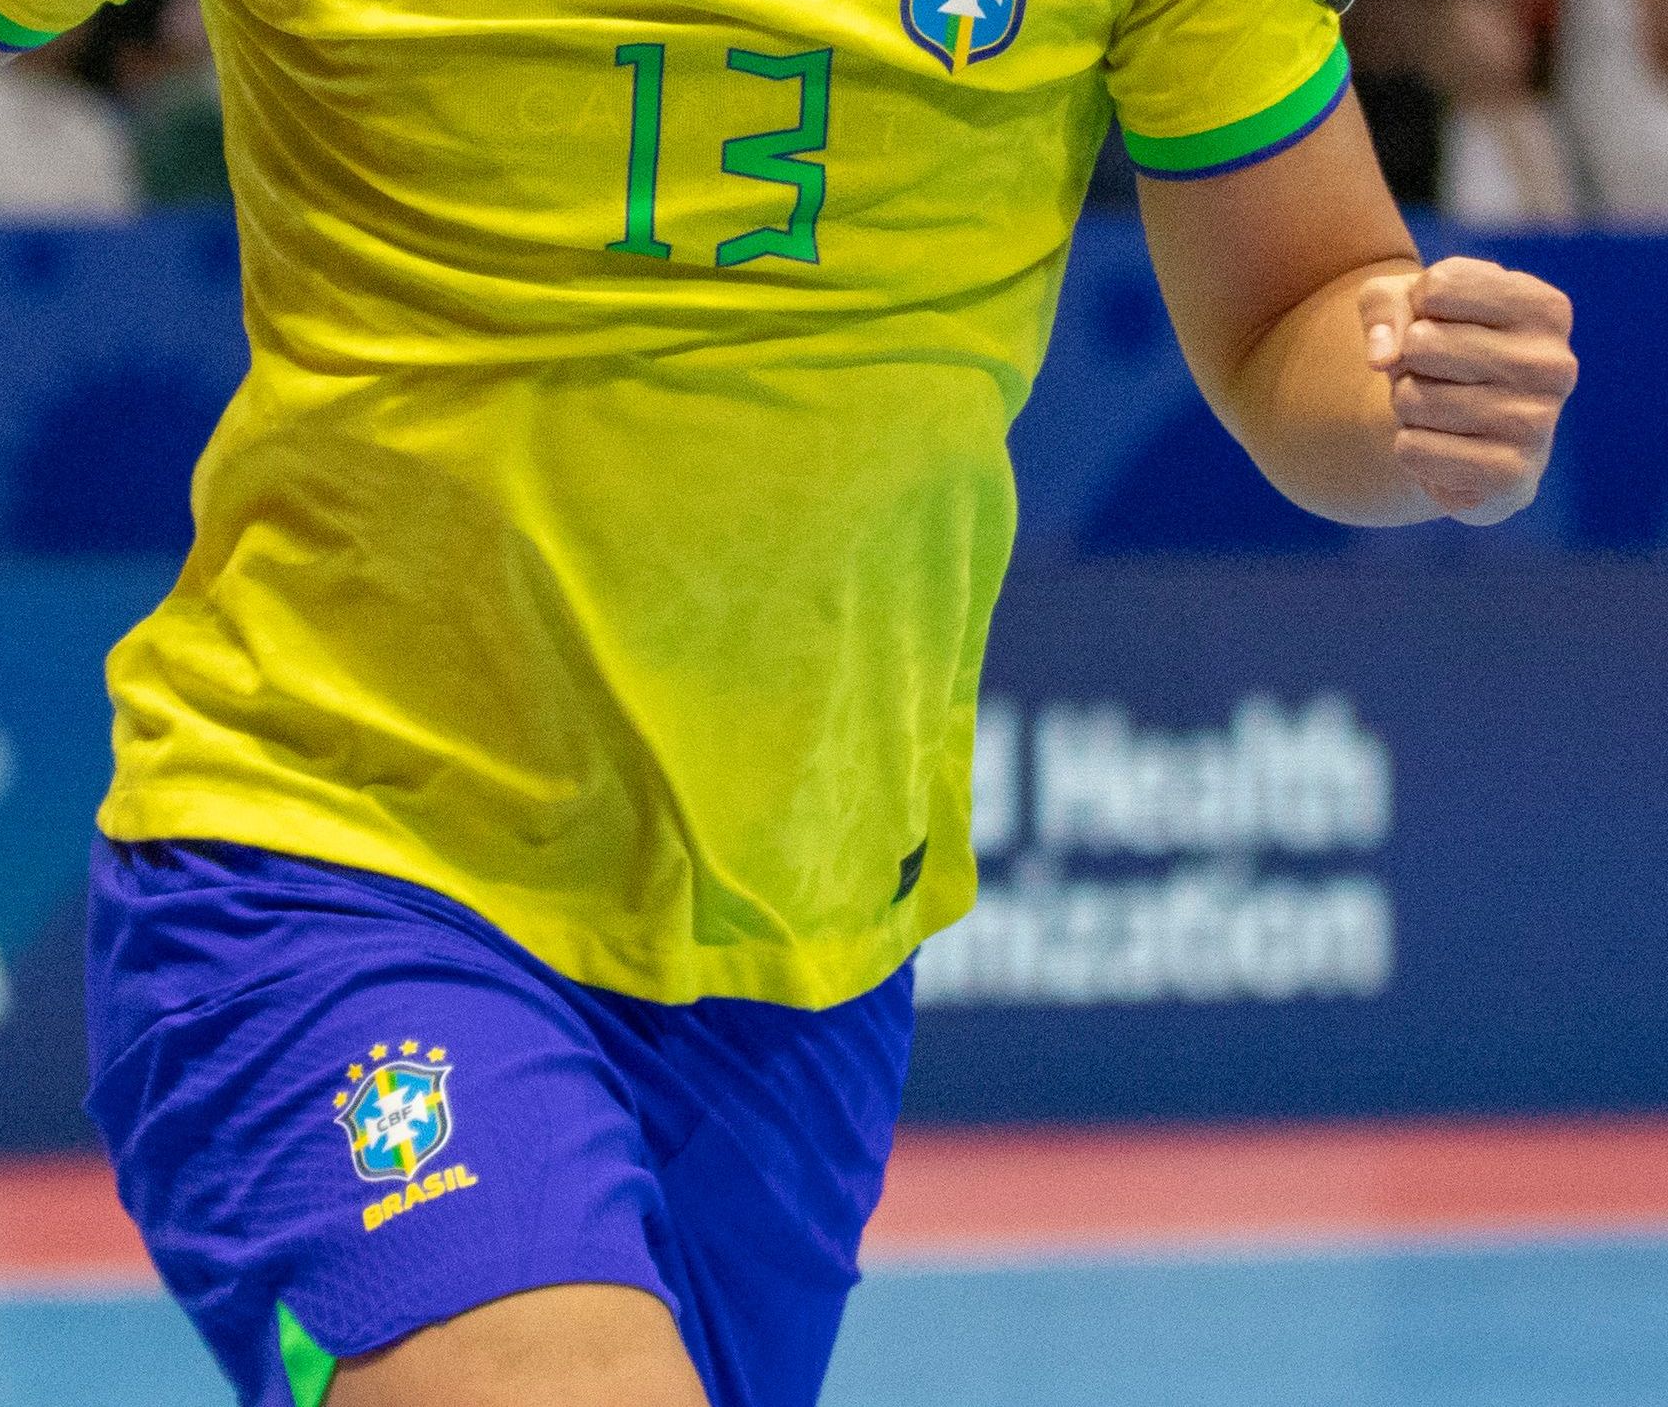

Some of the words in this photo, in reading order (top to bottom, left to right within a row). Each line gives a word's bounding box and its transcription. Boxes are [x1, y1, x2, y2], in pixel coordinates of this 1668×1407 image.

[605, 42, 833, 267] 13
[376, 1104, 413, 1133] CBF
[362, 1163, 478, 1232] BRASIL
